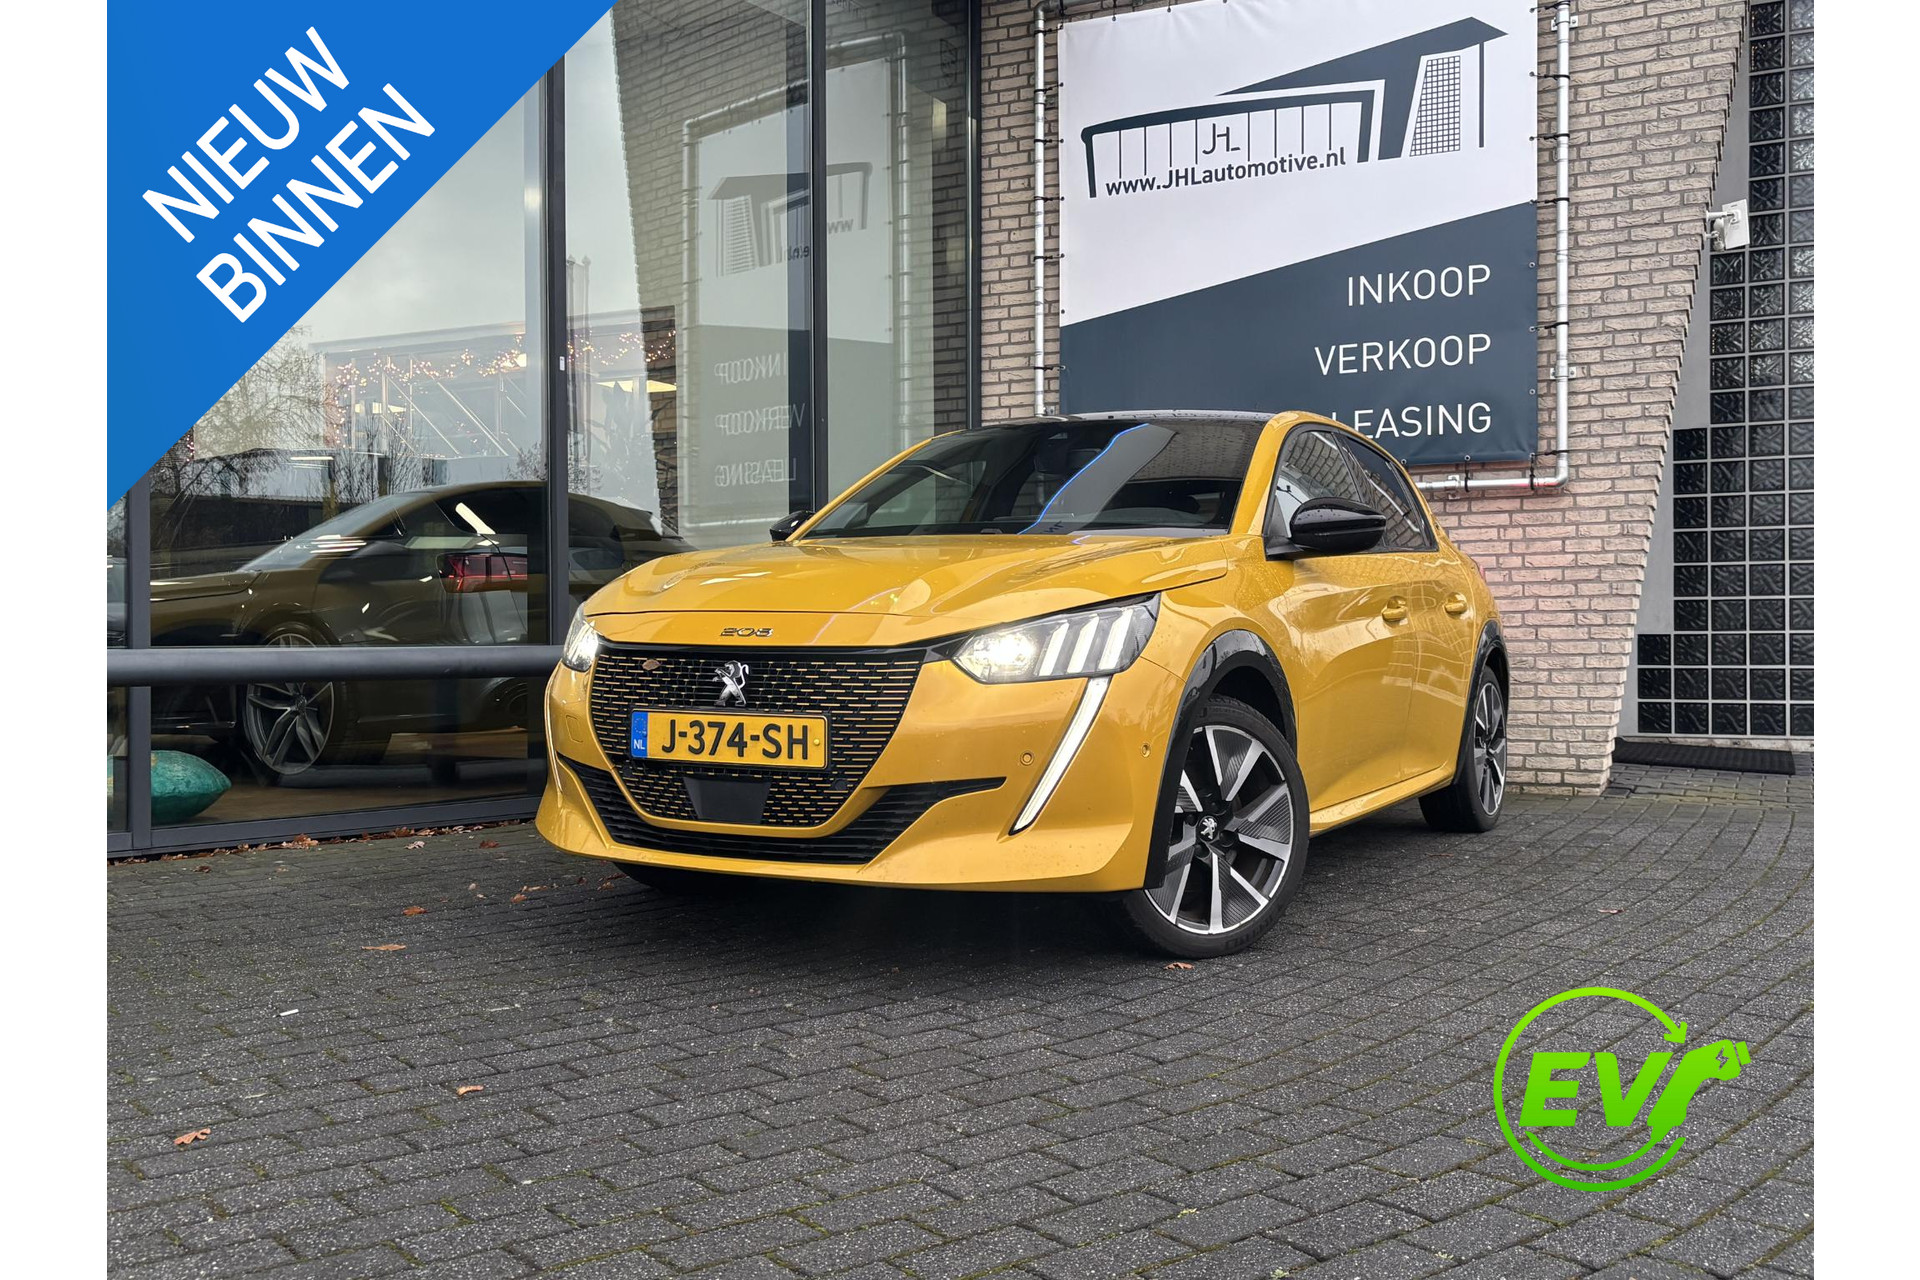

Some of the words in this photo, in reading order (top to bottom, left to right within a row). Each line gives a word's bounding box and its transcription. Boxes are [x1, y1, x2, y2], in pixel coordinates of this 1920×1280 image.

[1105, 147, 1346, 197] www.JHLautomotive.nl
[1348, 264, 1491, 306] INKOOP
[1314, 333, 1491, 376] VERKOOP
[1331, 402, 1491, 439] EASING
[633, 738, 645, 750] NL
[661, 719, 808, 760] J-374-SH
